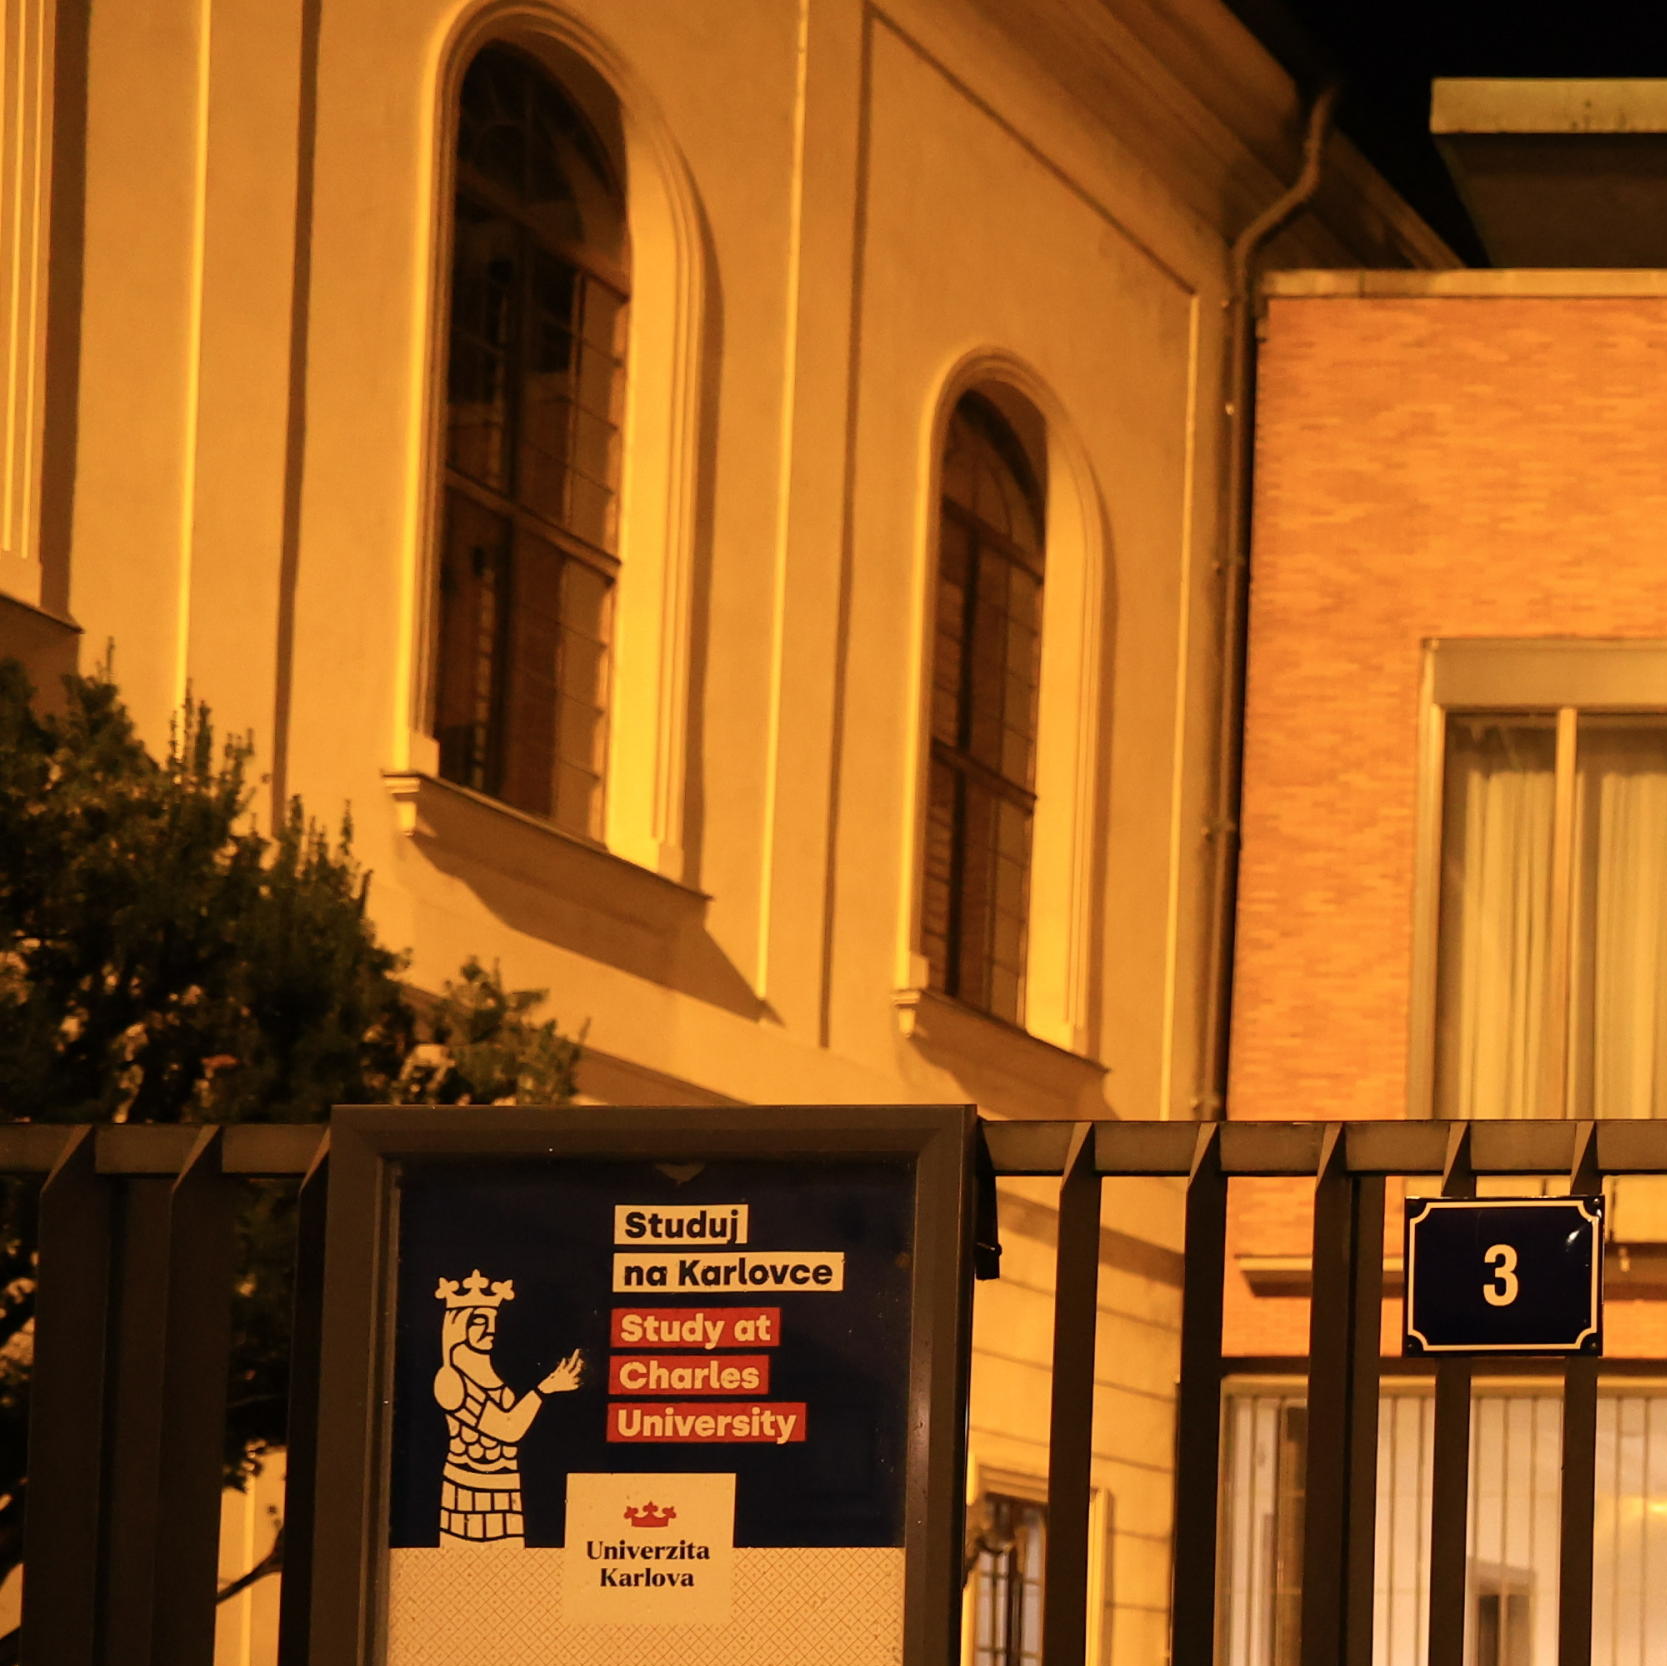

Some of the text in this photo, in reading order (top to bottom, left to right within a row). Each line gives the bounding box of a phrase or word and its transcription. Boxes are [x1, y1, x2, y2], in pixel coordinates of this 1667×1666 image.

[624, 1209, 739, 1245] Studuj
[623, 1256, 833, 1287] na Karlovce
[1482, 1243, 1520, 1308] 3
[620, 1312, 771, 1350] Study at
[618, 1359, 760, 1390] Charles
[616, 1406, 797, 1445] University
[586, 1539, 711, 1561] Univerzita
[600, 1567, 695, 1588] Karlova
